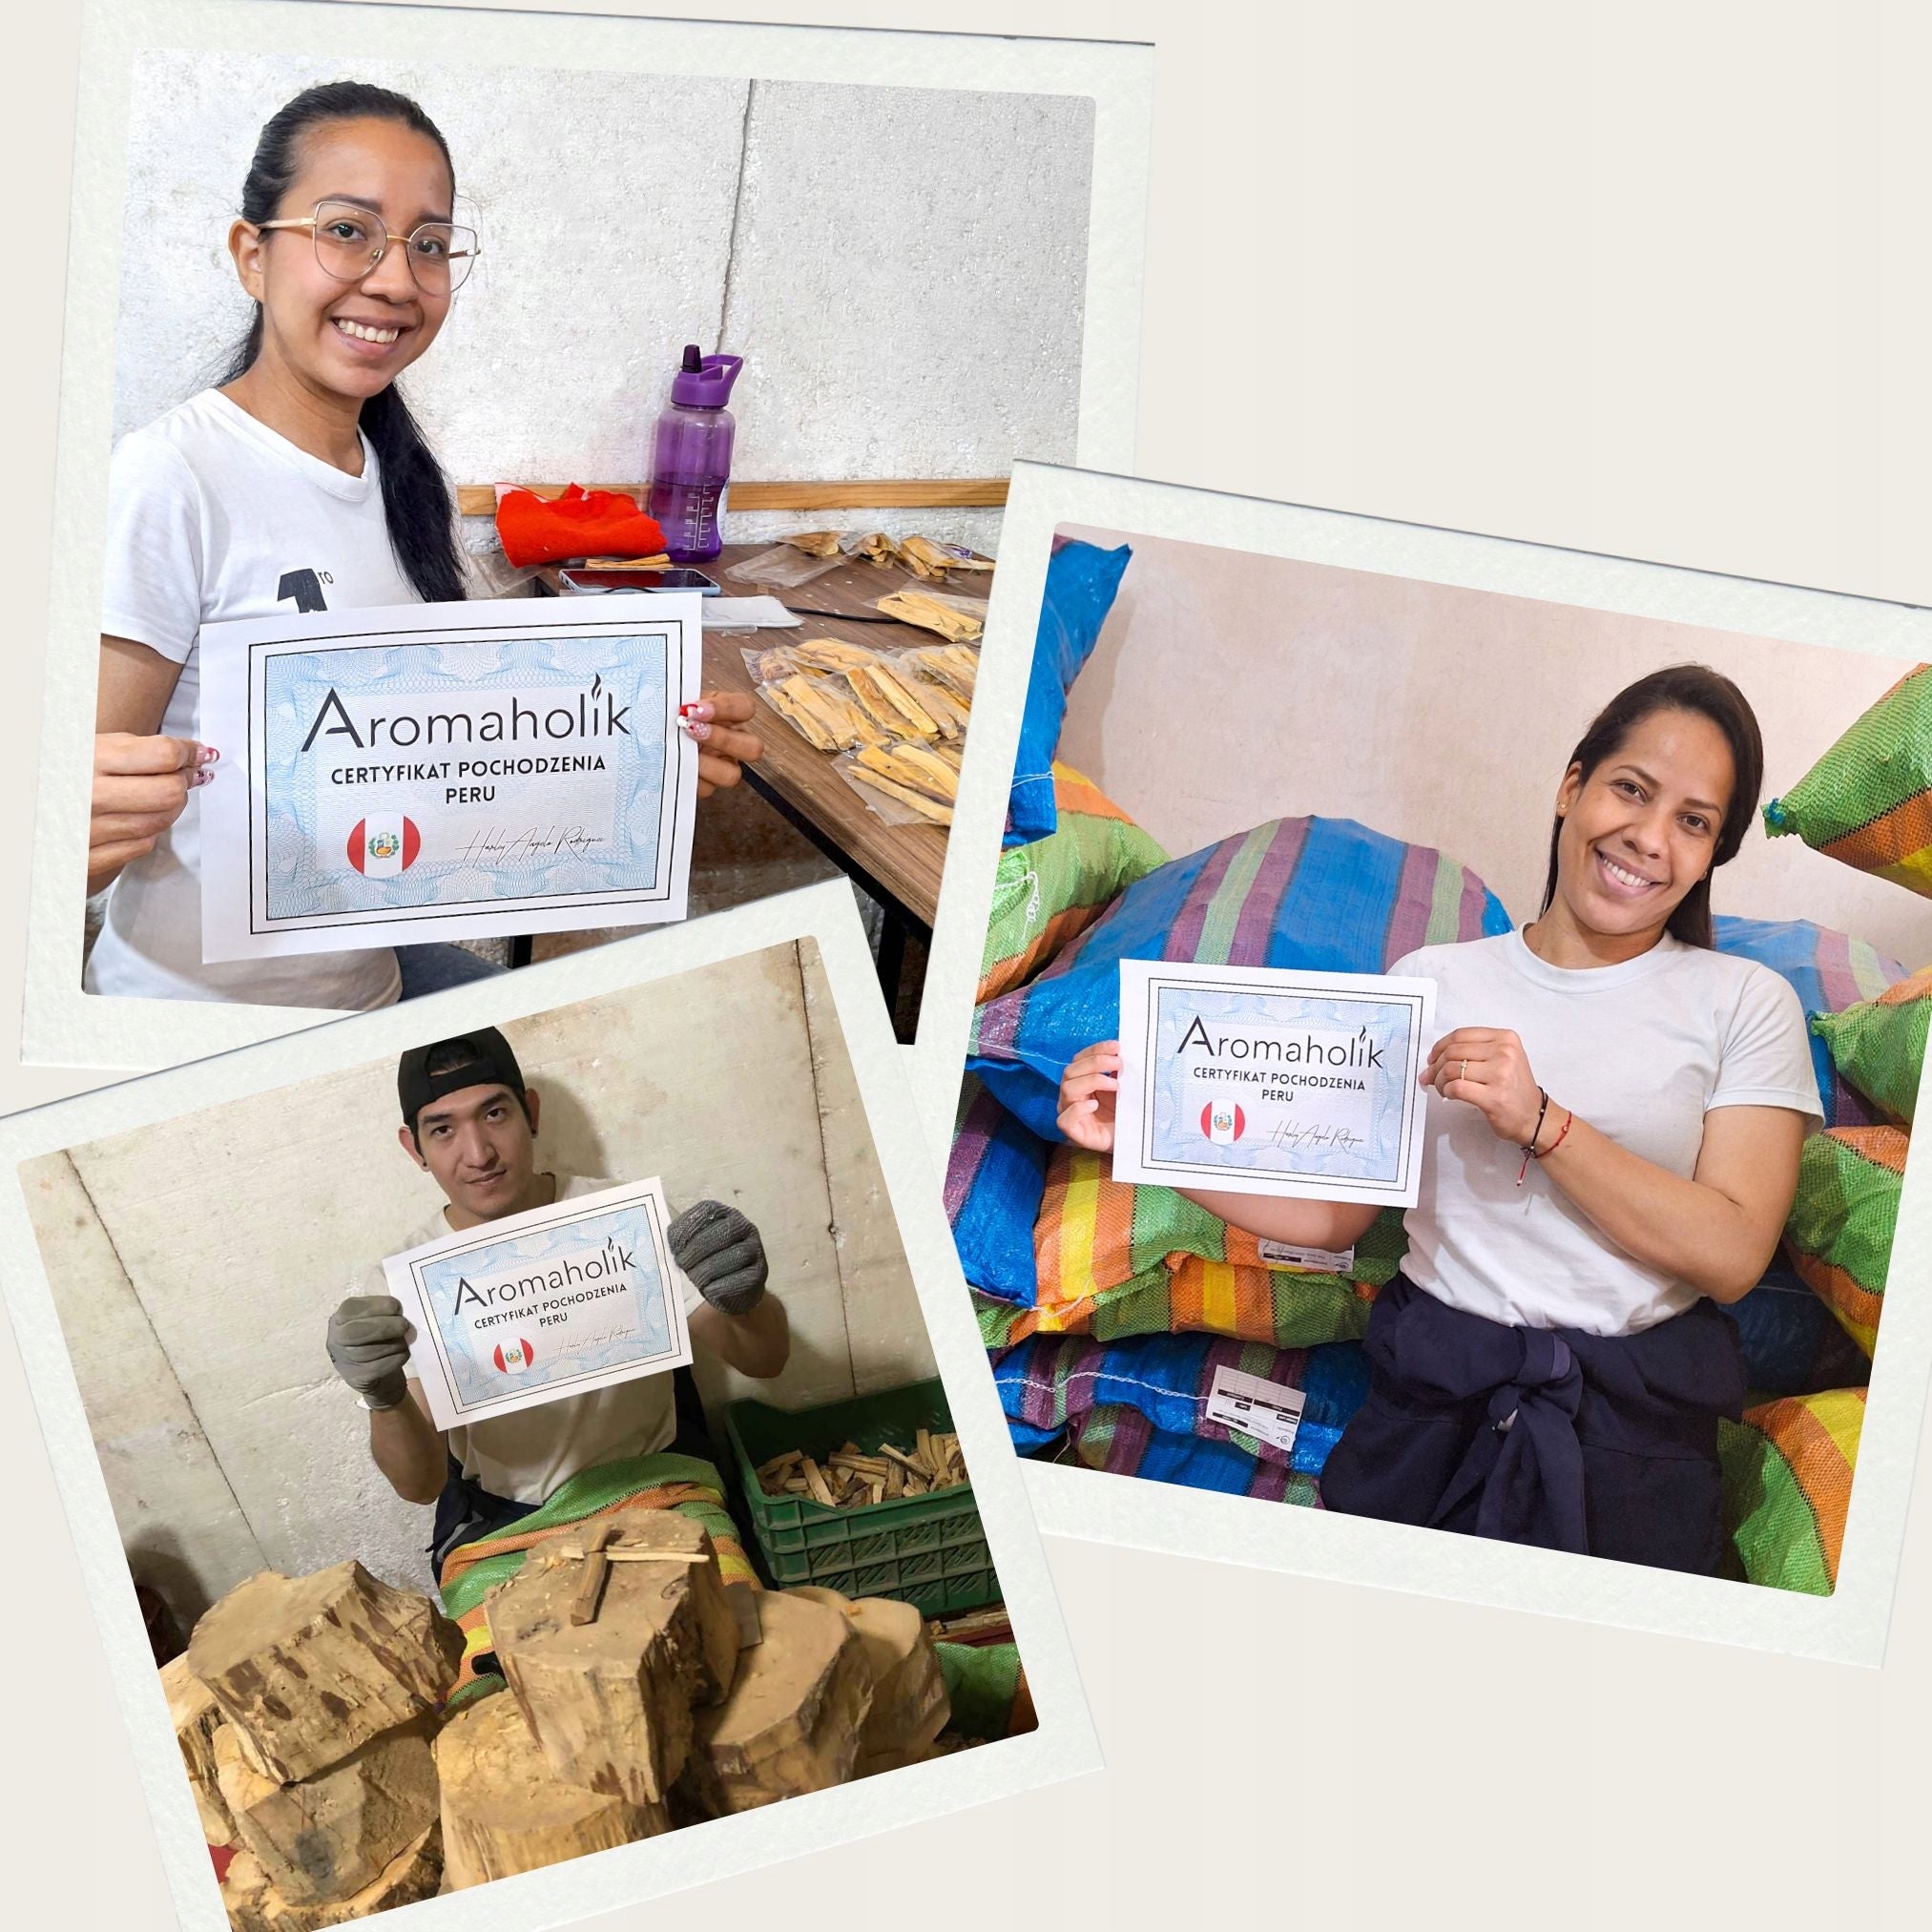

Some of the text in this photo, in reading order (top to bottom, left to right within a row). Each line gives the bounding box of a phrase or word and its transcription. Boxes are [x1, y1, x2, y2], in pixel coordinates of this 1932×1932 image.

[301, 673, 633, 753] Aromaholik
[331, 755, 606, 786] CERTYFIKAT POCHODZENIA
[446, 785, 496, 804] PERU
[1176, 1014, 1383, 1070] Aromaholik
[1194, 1067, 1366, 1091] CERTYFIKAT POCHODZENIA
[1262, 1089, 1294, 1103] PERU
[454, 1236, 637, 1316] Aromaholik
[474, 1282, 628, 1330] CERTYFIKAT POCHODZENIA
[539, 1312, 569, 1328] PERU
